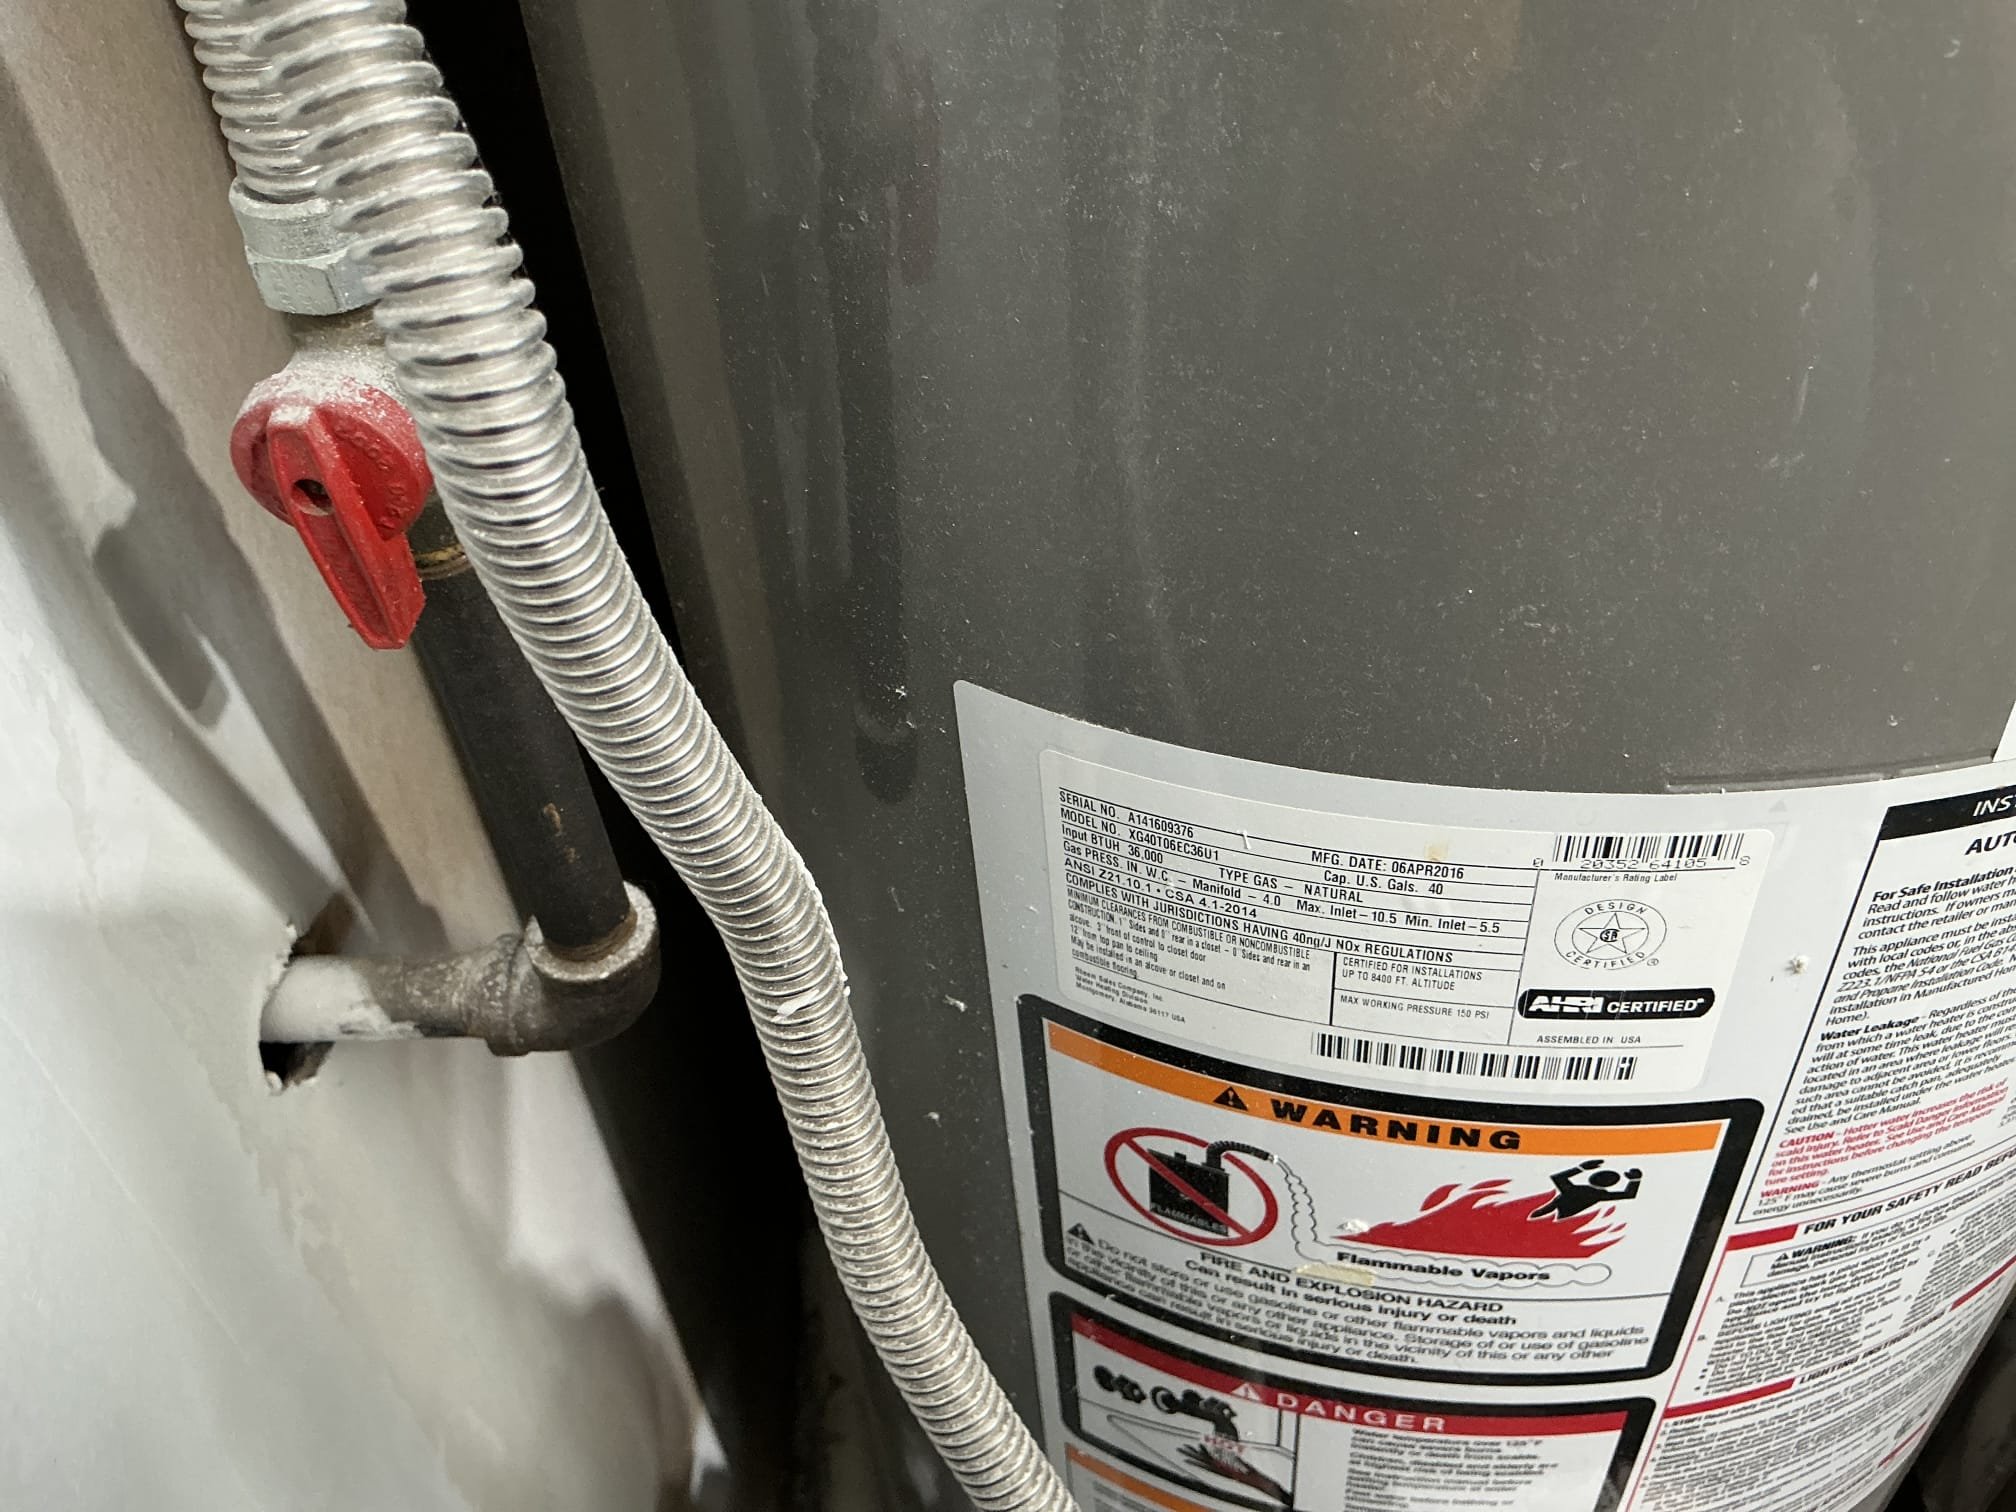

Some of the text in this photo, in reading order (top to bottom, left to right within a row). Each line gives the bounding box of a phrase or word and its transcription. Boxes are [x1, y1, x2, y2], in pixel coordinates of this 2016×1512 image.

[1059, 791, 1194, 838] SERIAL NO. A141609376
[1972, 794, 2016, 817] INS
[1060, 807, 1220, 862] MODEL NO. XG40T06EC36U1
[1061, 823, 1087, 843] Input
[1091, 834, 1121, 852] BTUH
[1063, 841, 1281, 907] Gas PRESS. IN. W.C. Manifold 4.0
[1311, 850, 1465, 880] MFG. DATE: 06APR2016
[1554, 872, 1678, 883] Manufacturer's Rating Label
[1580, 859, 1640, 870] 20352
[1649, 858, 1707, 870] 64105
[1064, 858, 1257, 918] ANSI Z21.10.1 CSA 4.1-2014
[1219, 867, 1364, 903] TYPE GAS NATURAL
[1324, 870, 1443, 895] Cap. U.S. Gals. 40
[1867, 879, 2006, 914] Read and follow water
[1872, 866, 2014, 902] For Safe Installation
[1065, 872, 1453, 963] COMPLIES WITH JURISDICTIONS HAVING 40ng/J NOx REGULATIONS
[1067, 888, 1310, 960] MINIMUM CLEARANCES FROM COMBUSTIBLE OR NONCOMBUSTIBLE
[1296, 899, 1500, 933] Max. Inlet 10.5 Min. Inlet 5.5
[1584, 902, 1648, 915] DESIGN
[1858, 906, 1989, 940] contact the retailer or
[1862, 891, 2000, 927] instructions. If owners
[1848, 955, 1876, 969] with
[1879, 949, 1907, 963] local
[1910, 941, 1944, 957] codes
[1964, 936, 1975, 945] in
[1977, 928, 1997, 940] the
[1852, 920, 1989, 957] This appliance must be
[1343, 956, 1482, 981] CERTIFIED FOR INSTALLATIONS
[1566, 950, 1646, 969] CERTIFIED
[1342, 969, 1455, 991] UP TO 8400 FT. ALTITUDE
[1829, 969, 1993, 1015] installation in Manufactured
[1340, 995, 1489, 1019] MAX WORKING PRESSURE 150 PSI
[1820, 998, 1987, 1041] Water Leakage Regardless
[1825, 1011, 1871, 1026] Home).
[1537, 1035, 1641, 1044] ASSEMBLED IN USA
[1816, 1013, 1965, 1053] from which water heater
[1270, 1098, 1521, 1151] WARNING
[1779, 1130, 1835, 1149] CAUTION
[1760, 1180, 1819, 1198] WARNING
[1804, 1218, 1837, 1235] FOR
[1841, 1206, 1883, 1224] YOUR
[1885, 1185, 1945, 1211] SAFETY
[1944, 1166, 1984, 1189] READ
[1200, 1252, 1504, 1313] FIRE AND EXPLOSION HAZARD
[1336, 1250, 1551, 1282] Flammable Vapors
[1185, 1259, 1517, 1325] Can result in serious injury or death
[1393, 1321, 1484, 1337] flammable
[1488, 1329, 1548, 1340] vapors
[1552, 1328, 1586, 1339] and
[1590, 1325, 1645, 1338] liquids
[1277, 1392, 1446, 1432] DANGER
